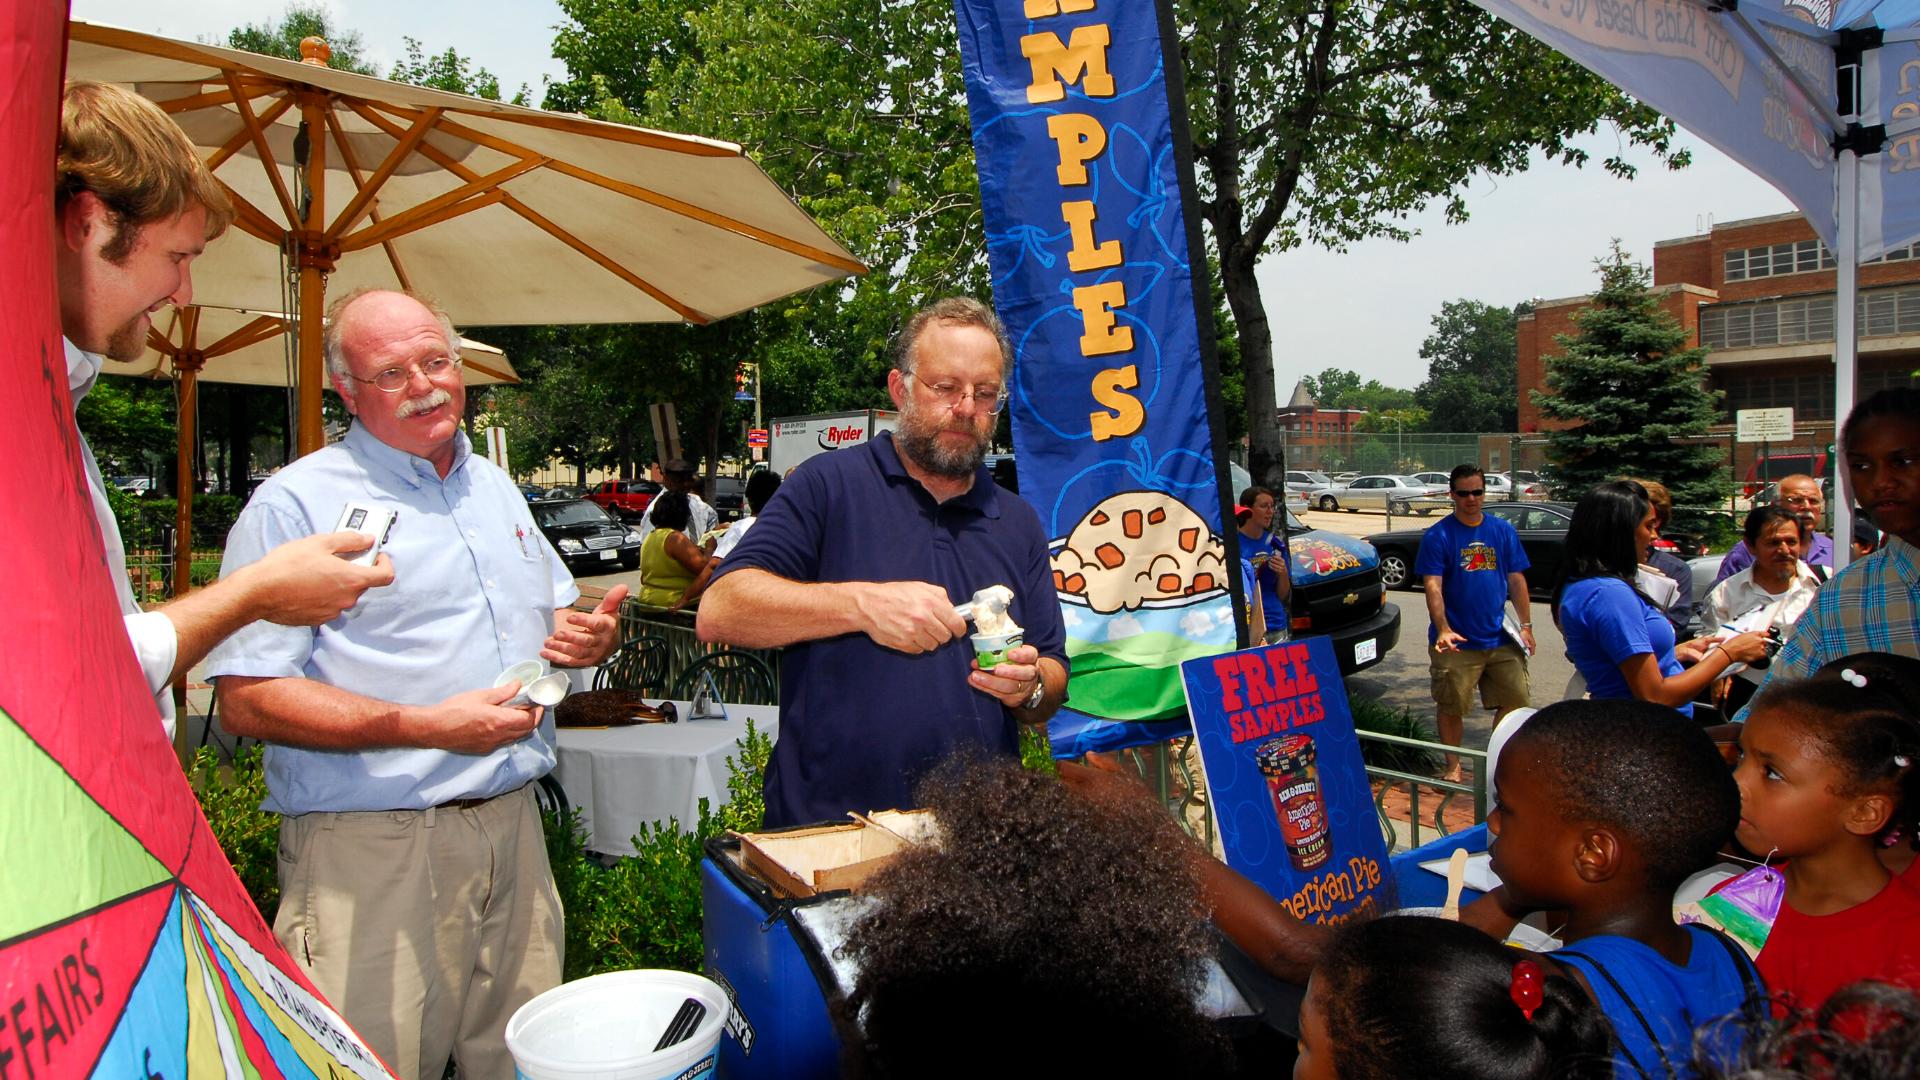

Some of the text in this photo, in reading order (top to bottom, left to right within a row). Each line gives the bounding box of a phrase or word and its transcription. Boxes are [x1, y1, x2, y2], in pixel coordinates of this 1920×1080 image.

[1020, 0, 1146, 441] MPLES
[828, 426, 862, 444] Ryder
[1213, 644, 1319, 712] FREE
[1229, 693, 1326, 744] SAMPLES
[1287, 800, 1317, 823] American
[1298, 818, 1312, 831] Pie
[1281, 876, 1355, 920] erican
[1348, 856, 1381, 893] Pie
